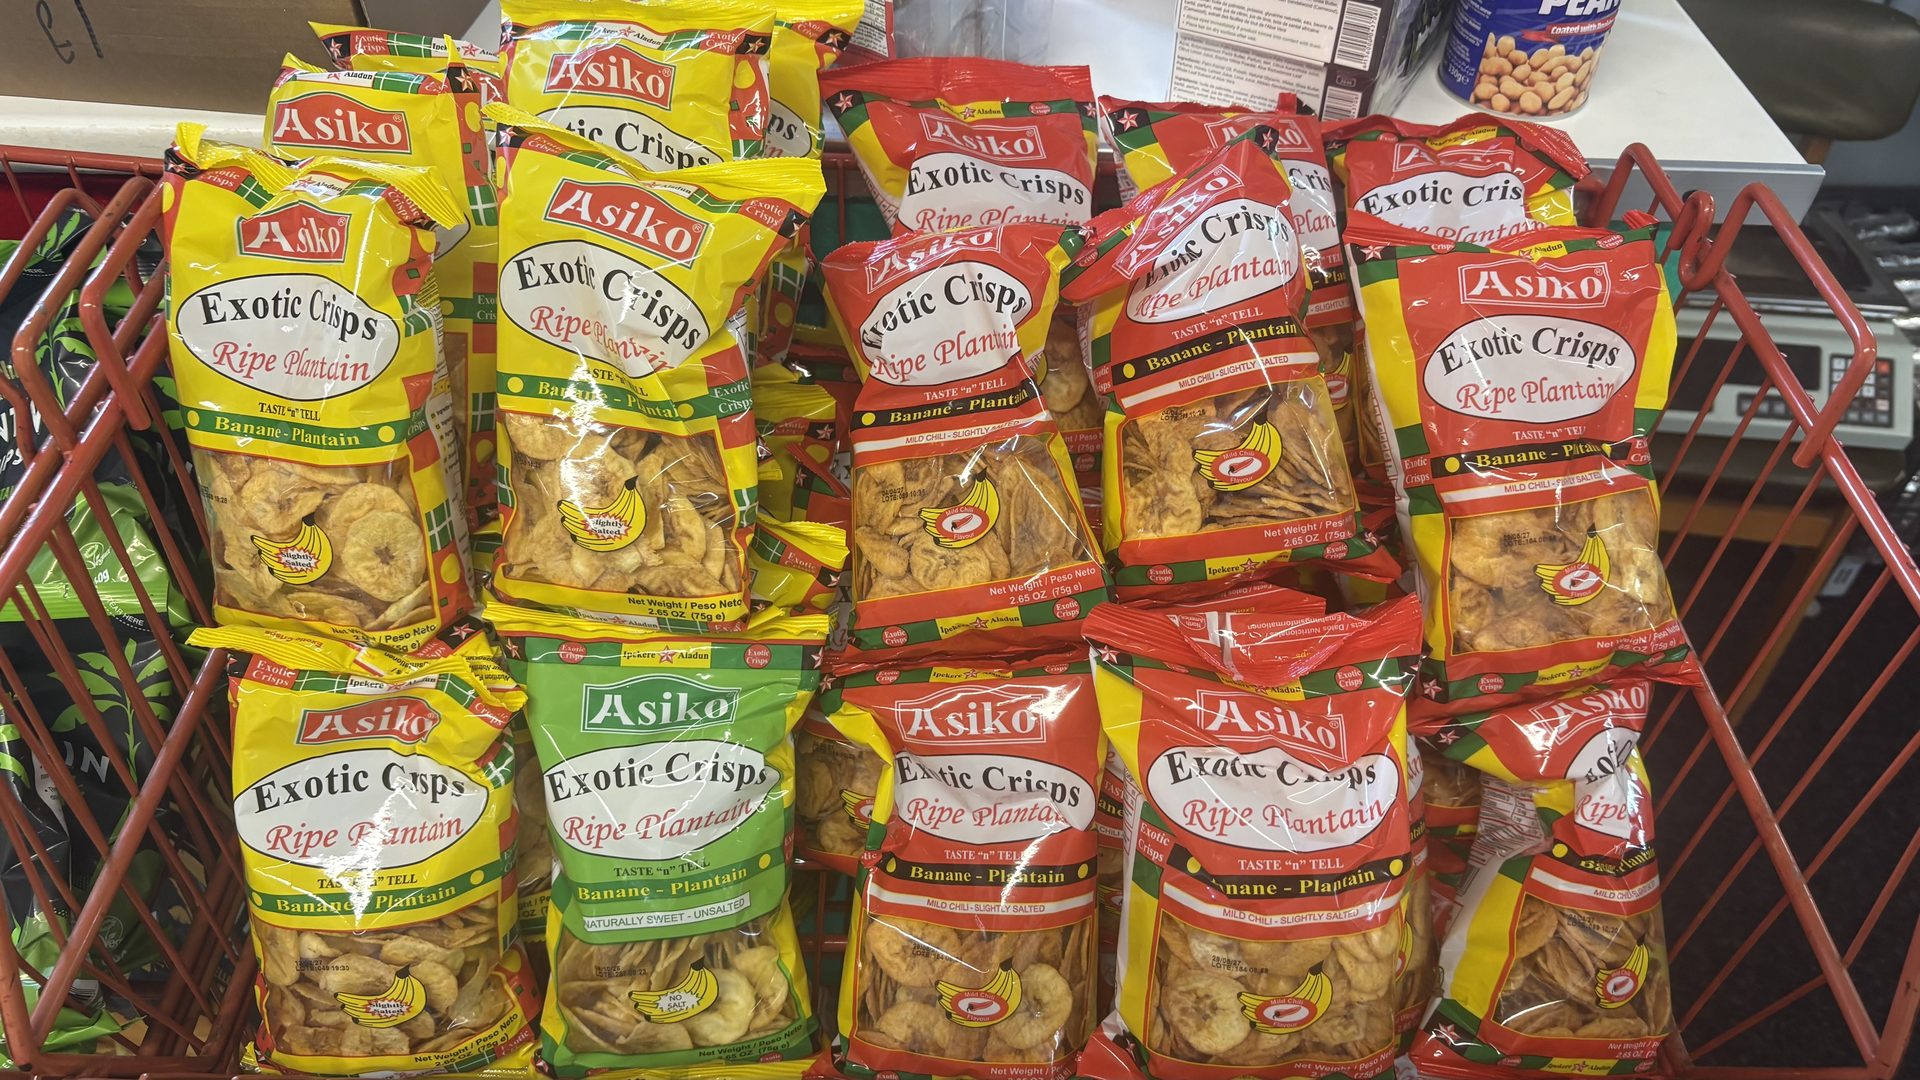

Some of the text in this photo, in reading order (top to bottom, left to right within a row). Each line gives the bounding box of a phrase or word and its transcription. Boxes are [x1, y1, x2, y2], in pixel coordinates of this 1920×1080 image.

[635, 31, 662, 47] Aladun
[1551, 26, 1580, 35] Coated
[344, 71, 373, 80] Aladun
[548, 56, 666, 100] Asiko
[273, 108, 402, 146] Asiko
[614, 122, 711, 168] Crisps
[931, 121, 1036, 157] Asiko
[906, 161, 1085, 206] Exotic Crisps
[749, 199, 783, 218] Exotic
[1360, 179, 1453, 216] Exotic
[551, 188, 695, 254] Asiko
[1201, 204, 1290, 244] Crisps
[246, 216, 341, 255] Asiko
[874, 228, 995, 284] Asiko
[1188, 256, 1294, 300] Plantain
[513, 254, 701, 350] Exotic Crisps
[943, 271, 1027, 315] Crisps
[199, 287, 378, 342] Exotic Crisps
[530, 304, 592, 343] Ripe
[1171, 307, 1264, 341] TASTE TELL
[1146, 321, 1297, 371] Banane Plantain
[1436, 326, 1620, 377] Exotic Crisps
[212, 340, 371, 382] Ripe Plantain
[874, 354, 926, 383] Ripe
[1178, 361, 1257, 390] MILD CHILI SLIGHTLY
[713, 381, 750, 398] Exotic
[923, 378, 1007, 401] TASTE TELL
[1456, 376, 1615, 414] Ripe Plantain
[889, 388, 1029, 424] Banane Plantain
[214, 415, 360, 448] Banane Plantain
[905, 426, 991, 444] MILD CHILI SLIGHTLY
[1513, 430, 1545, 441] TASTE
[1403, 457, 1428, 470] Exotic
[1476, 450, 1547, 468] Banane
[1230, 476, 1254, 485] Flavour
[1405, 472, 1430, 484] Crisps
[1504, 481, 1550, 494] MILD CHILI
[1264, 520, 1317, 538] Net Weight
[1284, 533, 1320, 548] 2.65 OZ
[280, 550, 314, 564] Slightly
[284, 558, 312, 569] Salted
[989, 566, 1096, 596] Net Weight Peso Neto
[1149, 567, 1173, 577] Exotic
[1208, 564, 1240, 575] Ipekere
[106, 596, 124, 618] TEAR
[628, 597, 743, 611] Net Weight Peso Neto
[1010, 590, 1047, 605] 2.65 OZ
[1055, 601, 1078, 611] Exotic
[123, 612, 144, 626] HERE
[648, 608, 712, 622] 2.65 OZ (75g
[990, 614, 1020, 624] Aladun
[1056, 607, 1080, 618] Crisps
[678, 650, 710, 660] Aladun
[252, 669, 289, 687] Crisps
[256, 660, 296, 678] Exotic
[932, 670, 963, 680] Ipekere
[1337, 669, 1362, 679] Exotic
[349, 679, 385, 690] Ipekere
[1338, 676, 1363, 688] Crisps
[588, 691, 728, 726] Asiko
[907, 701, 1037, 738] Asiko
[305, 705, 432, 740] Asiko
[1205, 700, 1337, 750] Asiko
[546, 751, 767, 803] Exotic Crisps
[1164, 751, 1267, 785] Exotic
[252, 763, 369, 814] Exotic
[982, 766, 1081, 807] Crisps
[907, 797, 966, 831] Ripe
[1182, 798, 1384, 837] Ripe Plantain
[1576, 794, 1627, 826] Ripe
[562, 799, 752, 849] Ripe Plantain
[1140, 823, 1170, 847] Exotic
[265, 822, 338, 858] Ripe
[1138, 840, 1165, 862] Crisps
[944, 850, 977, 861] TASTE
[1238, 858, 1344, 871] TASTE TELL
[387, 875, 418, 886] TELL
[614, 860, 710, 878] TASTE TELL
[910, 867, 1065, 884] Banane Plantain
[577, 868, 748, 901] Banane Plantain
[1300, 869, 1375, 894] Plantain
[276, 885, 456, 916] Banane Plantain
[926, 899, 1046, 913] MILD CHILI SLIGHTLY SALTED
[584, 897, 745, 930] NATURALLY SWEET UNSALTED
[1222, 908, 1324, 925] MILD CHILI SLIGHTLY
[669, 994, 683, 1002] NO
[990, 1067, 1044, 1077] Net Weight
